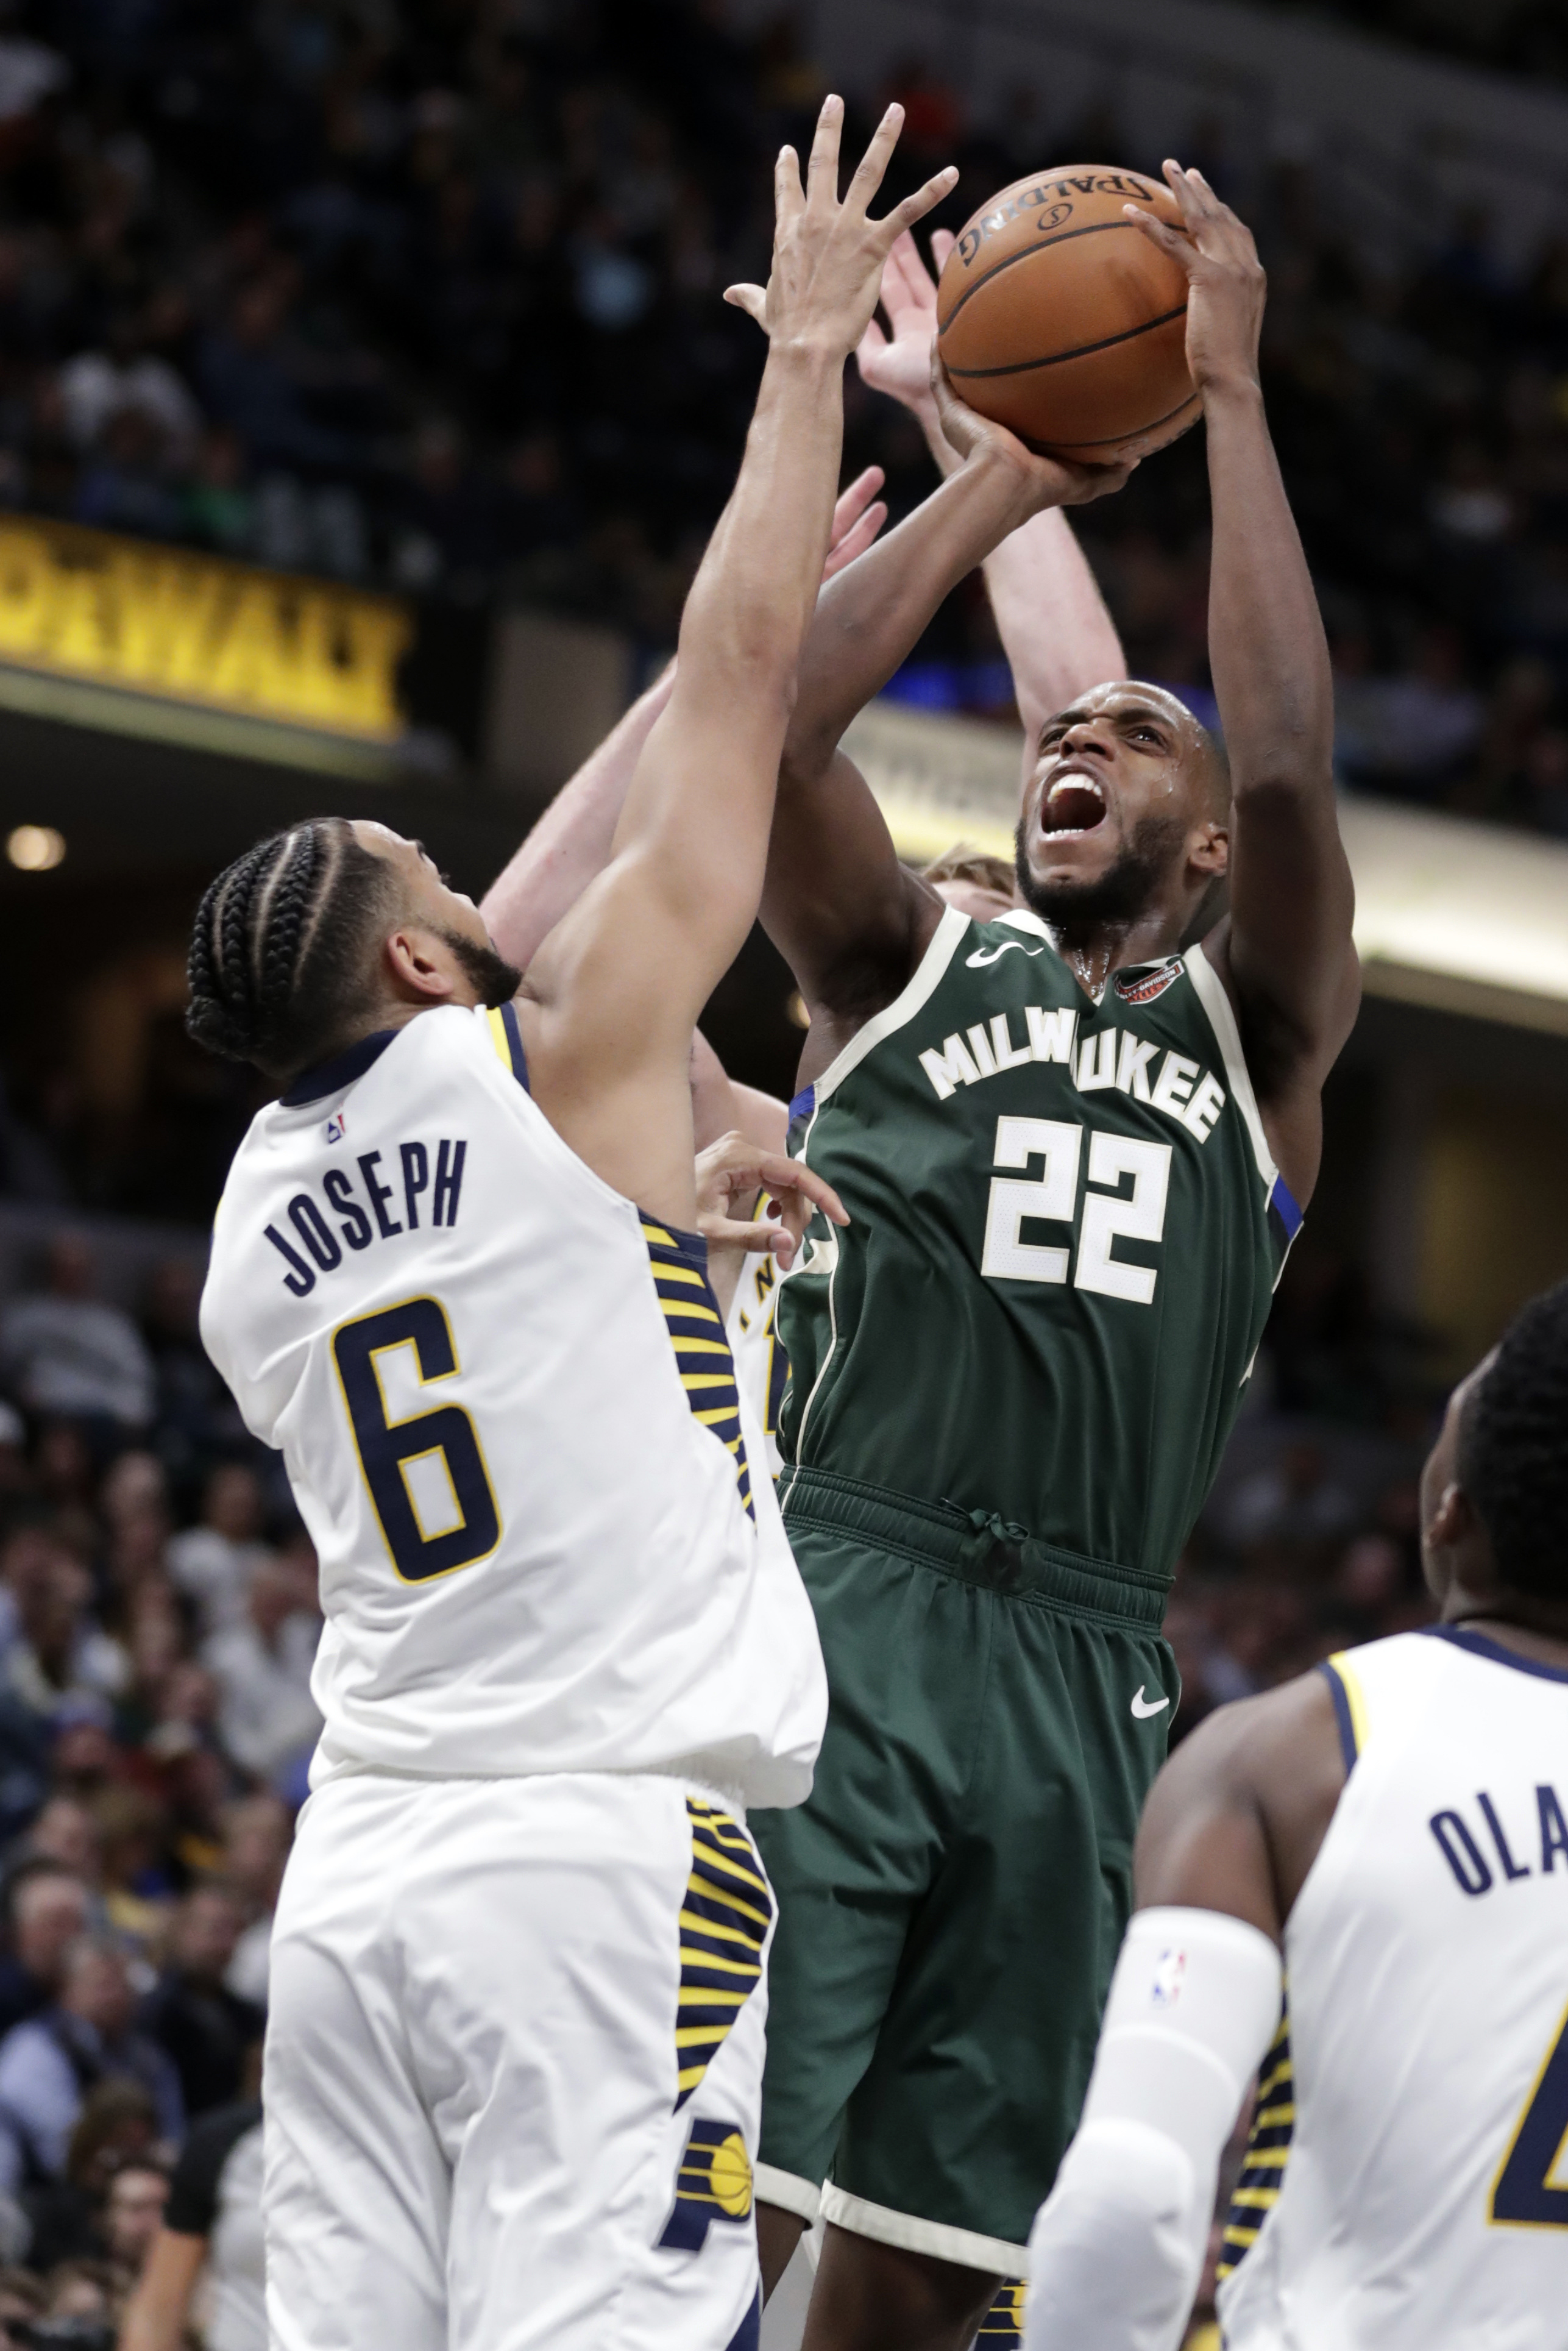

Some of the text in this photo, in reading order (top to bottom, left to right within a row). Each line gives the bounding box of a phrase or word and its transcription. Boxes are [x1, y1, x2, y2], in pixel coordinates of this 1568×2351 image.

[959, 175, 1154, 267] SPALDING
[263, 1139, 467, 1297] JOSEPH
[981, 1115, 1172, 1304] 22
[330, 1293, 503, 1587] 6
